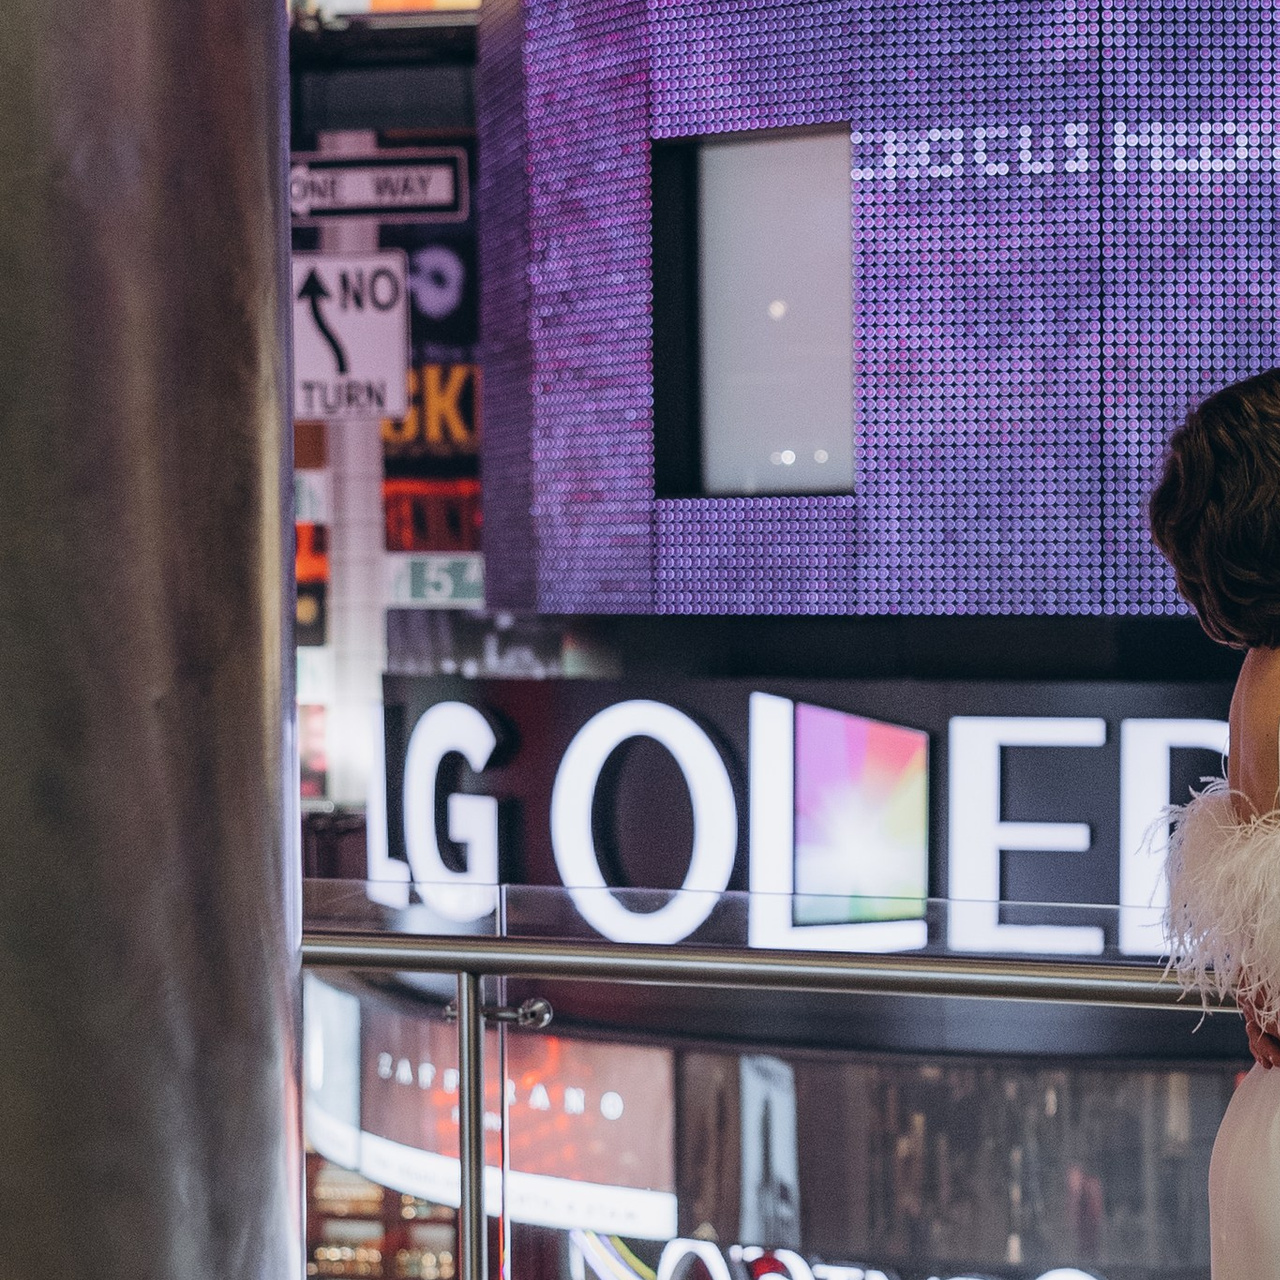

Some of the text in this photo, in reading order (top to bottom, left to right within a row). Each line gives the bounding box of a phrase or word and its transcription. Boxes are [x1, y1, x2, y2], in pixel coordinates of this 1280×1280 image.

[372, 172, 433, 200] WAY
[338, 268, 399, 312] NO
[301, 379, 385, 414] TURN
[365, 700, 499, 922] LG
